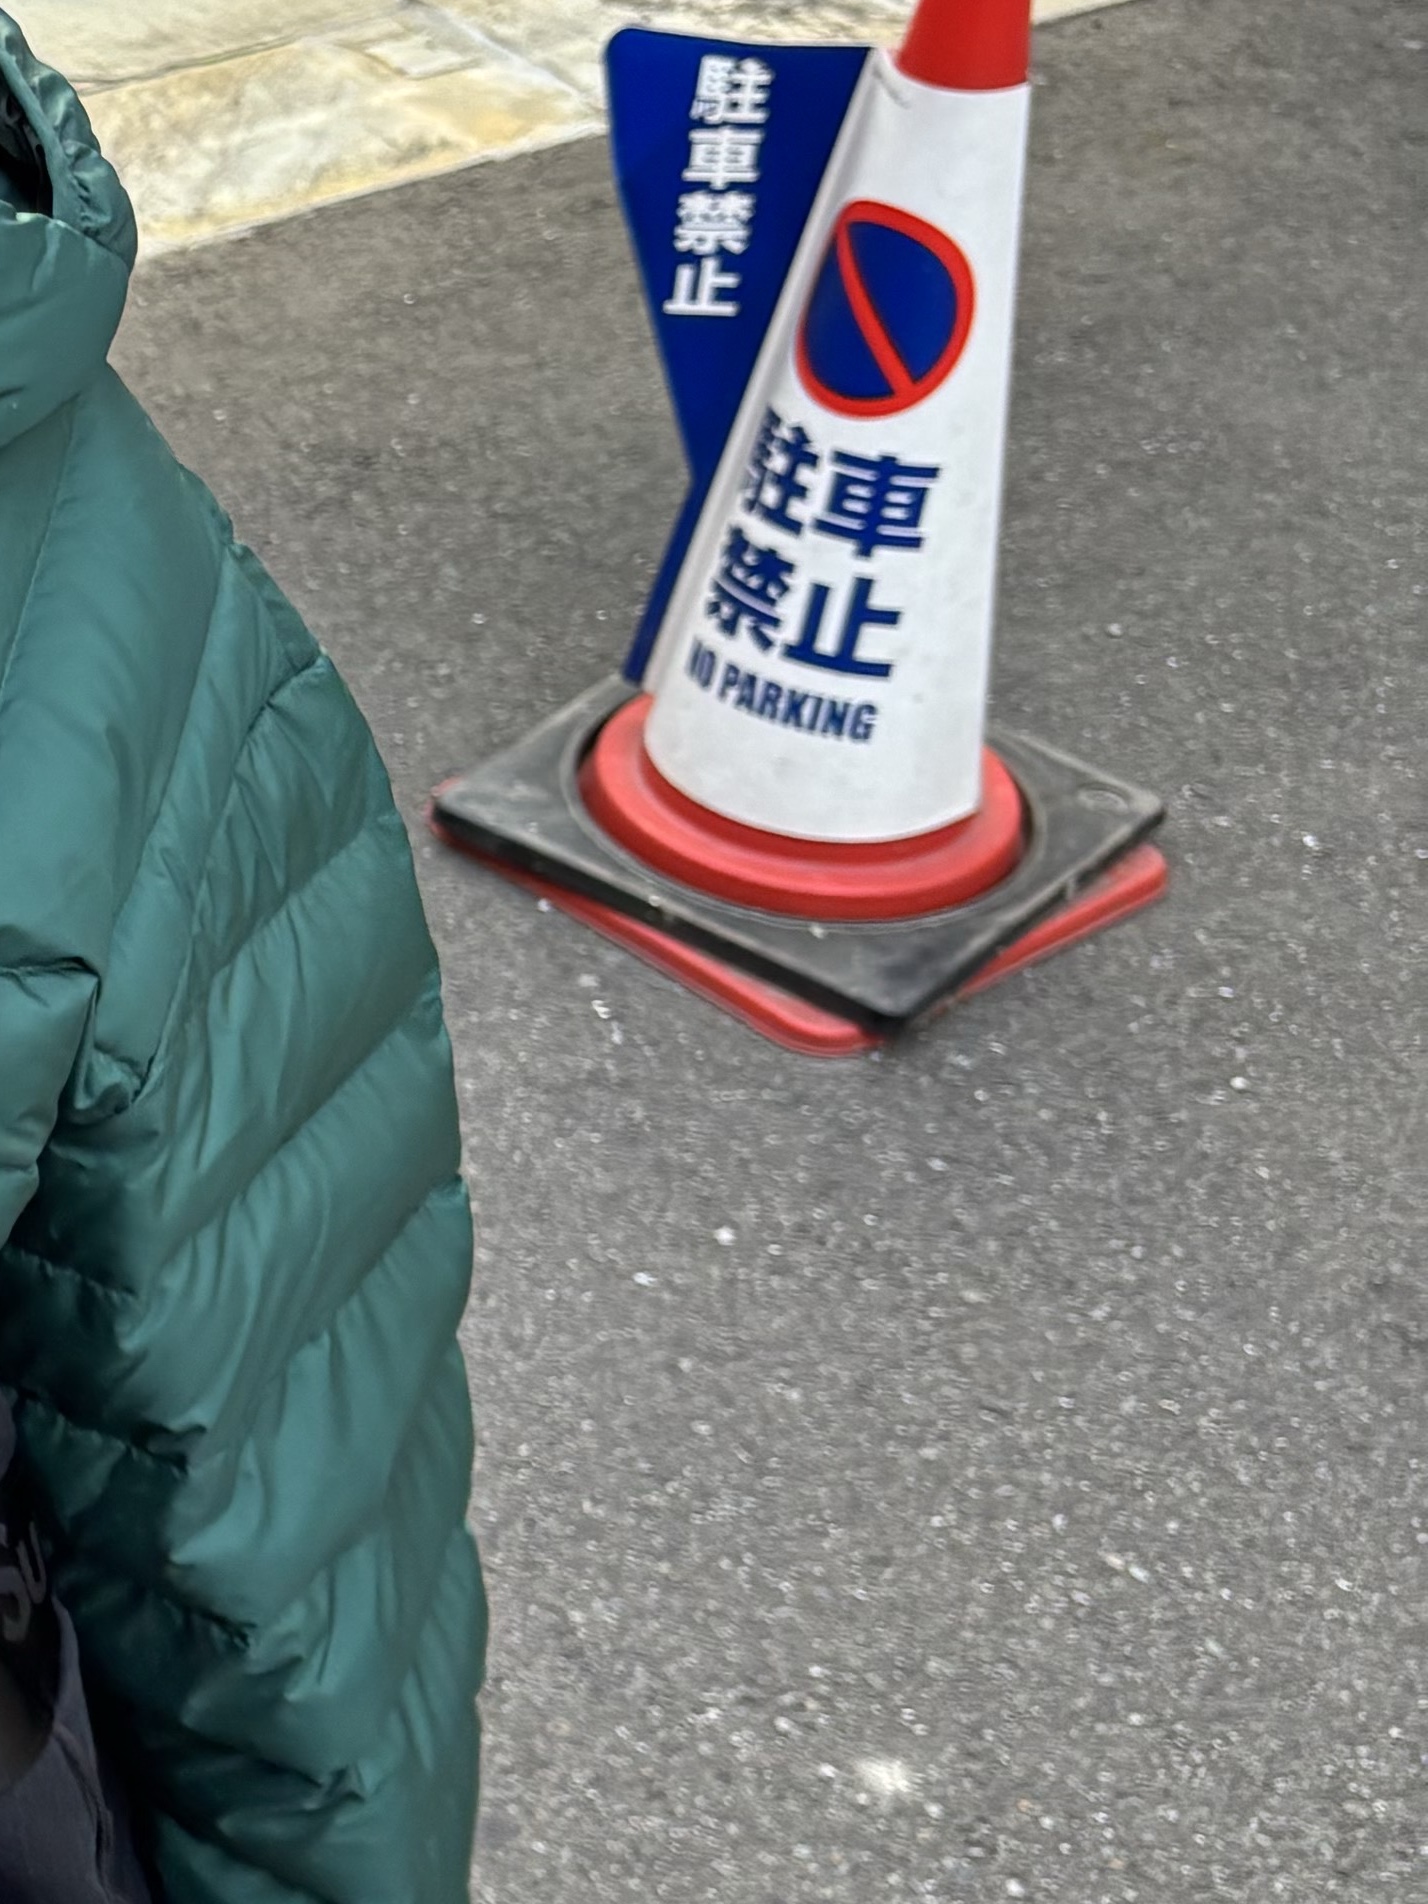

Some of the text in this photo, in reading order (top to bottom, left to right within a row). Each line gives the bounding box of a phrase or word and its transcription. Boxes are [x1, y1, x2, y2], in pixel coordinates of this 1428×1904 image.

[662, 53, 776, 318] 駐車禁止
[741, 407, 941, 559] 駐車
[705, 524, 902, 679] 禁止
[717, 661, 879, 742] PARKING
